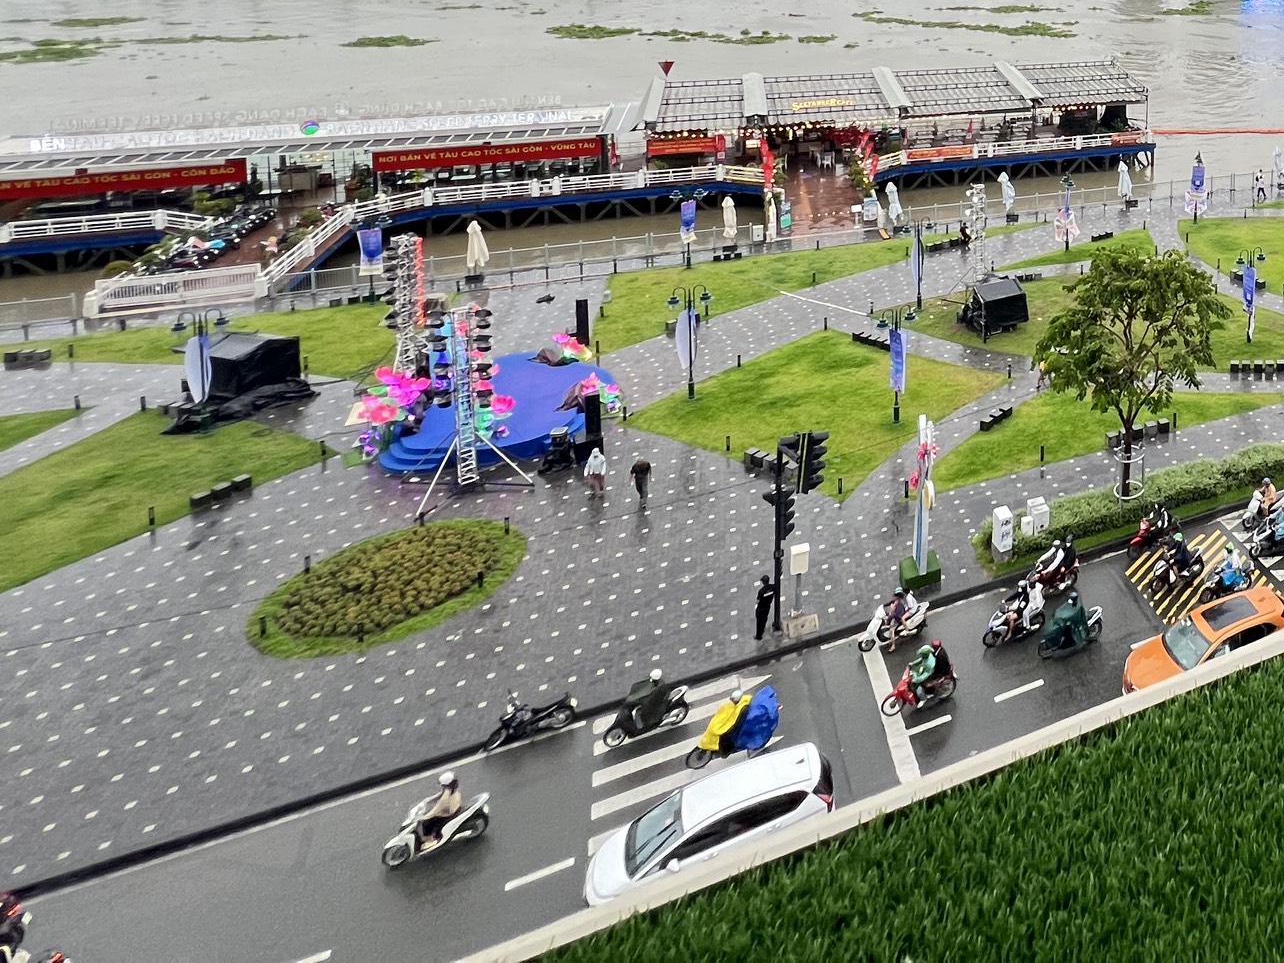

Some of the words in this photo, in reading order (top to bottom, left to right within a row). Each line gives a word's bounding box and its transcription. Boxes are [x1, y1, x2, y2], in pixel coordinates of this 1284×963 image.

[400, 153, 421, 162] BÁN
[439, 150, 458, 158] TÀU
[461, 149, 481, 157] CAO
[484, 146, 502, 155] TỐC
[505, 146, 520, 154] SÀI
[522, 145, 543, 153] GÒN
[550, 142, 576, 151] VŨNG
[578, 141, 596, 149] TÀU
[64, 177, 91, 185] CAO
[144, 170, 171, 180] GÒN
